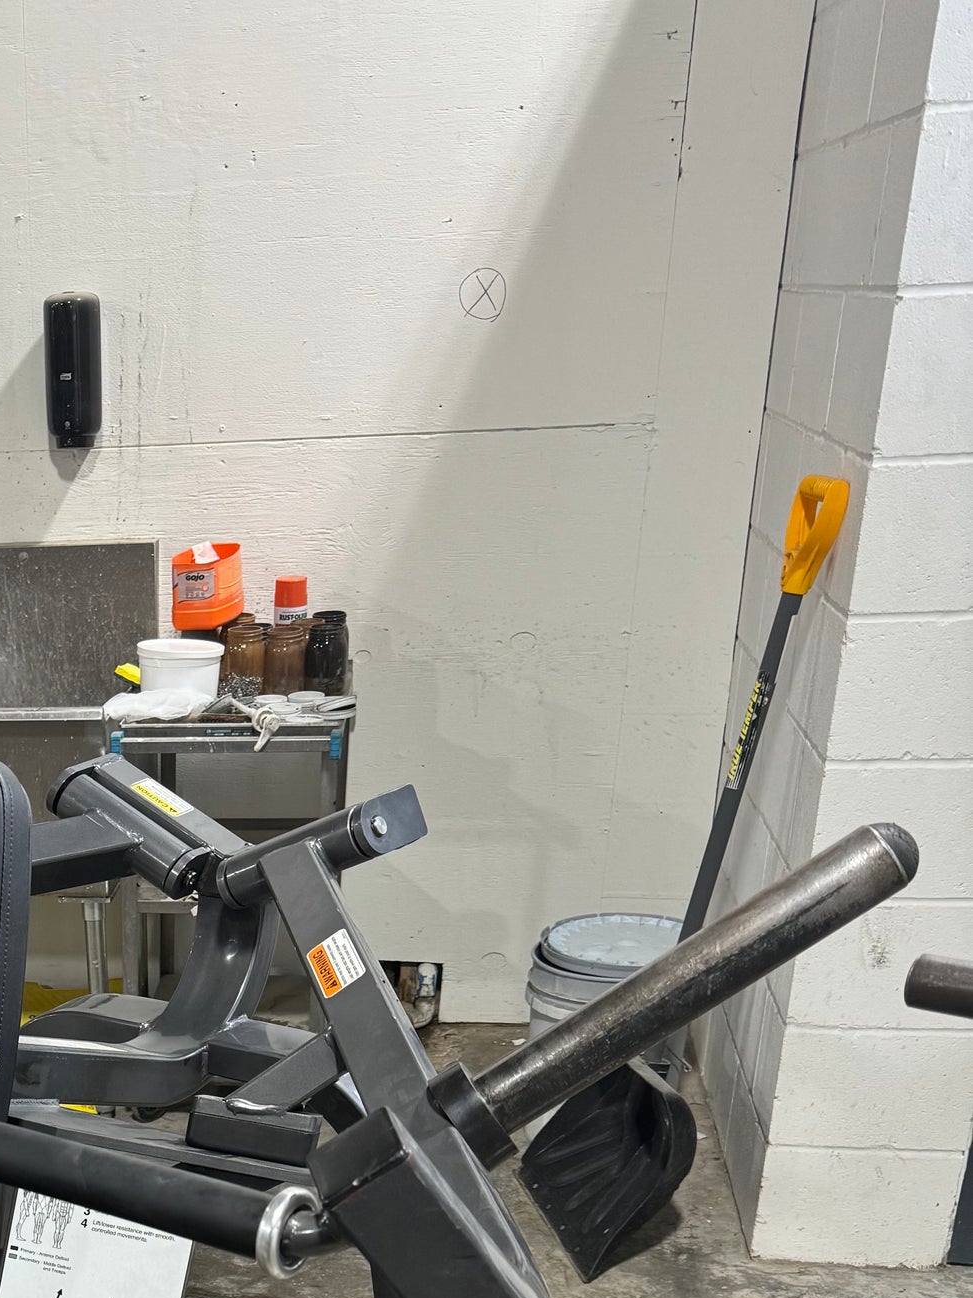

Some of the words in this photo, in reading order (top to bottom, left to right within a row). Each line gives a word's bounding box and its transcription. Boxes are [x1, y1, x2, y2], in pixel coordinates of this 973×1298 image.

[136, 785, 169, 808] CAUTION
[312, 950, 335, 987] WARNING
[80, 1218, 88, 1228] 4
[116, 1225, 143, 1234] resistance
[91, 1227, 117, 1236] controlled
